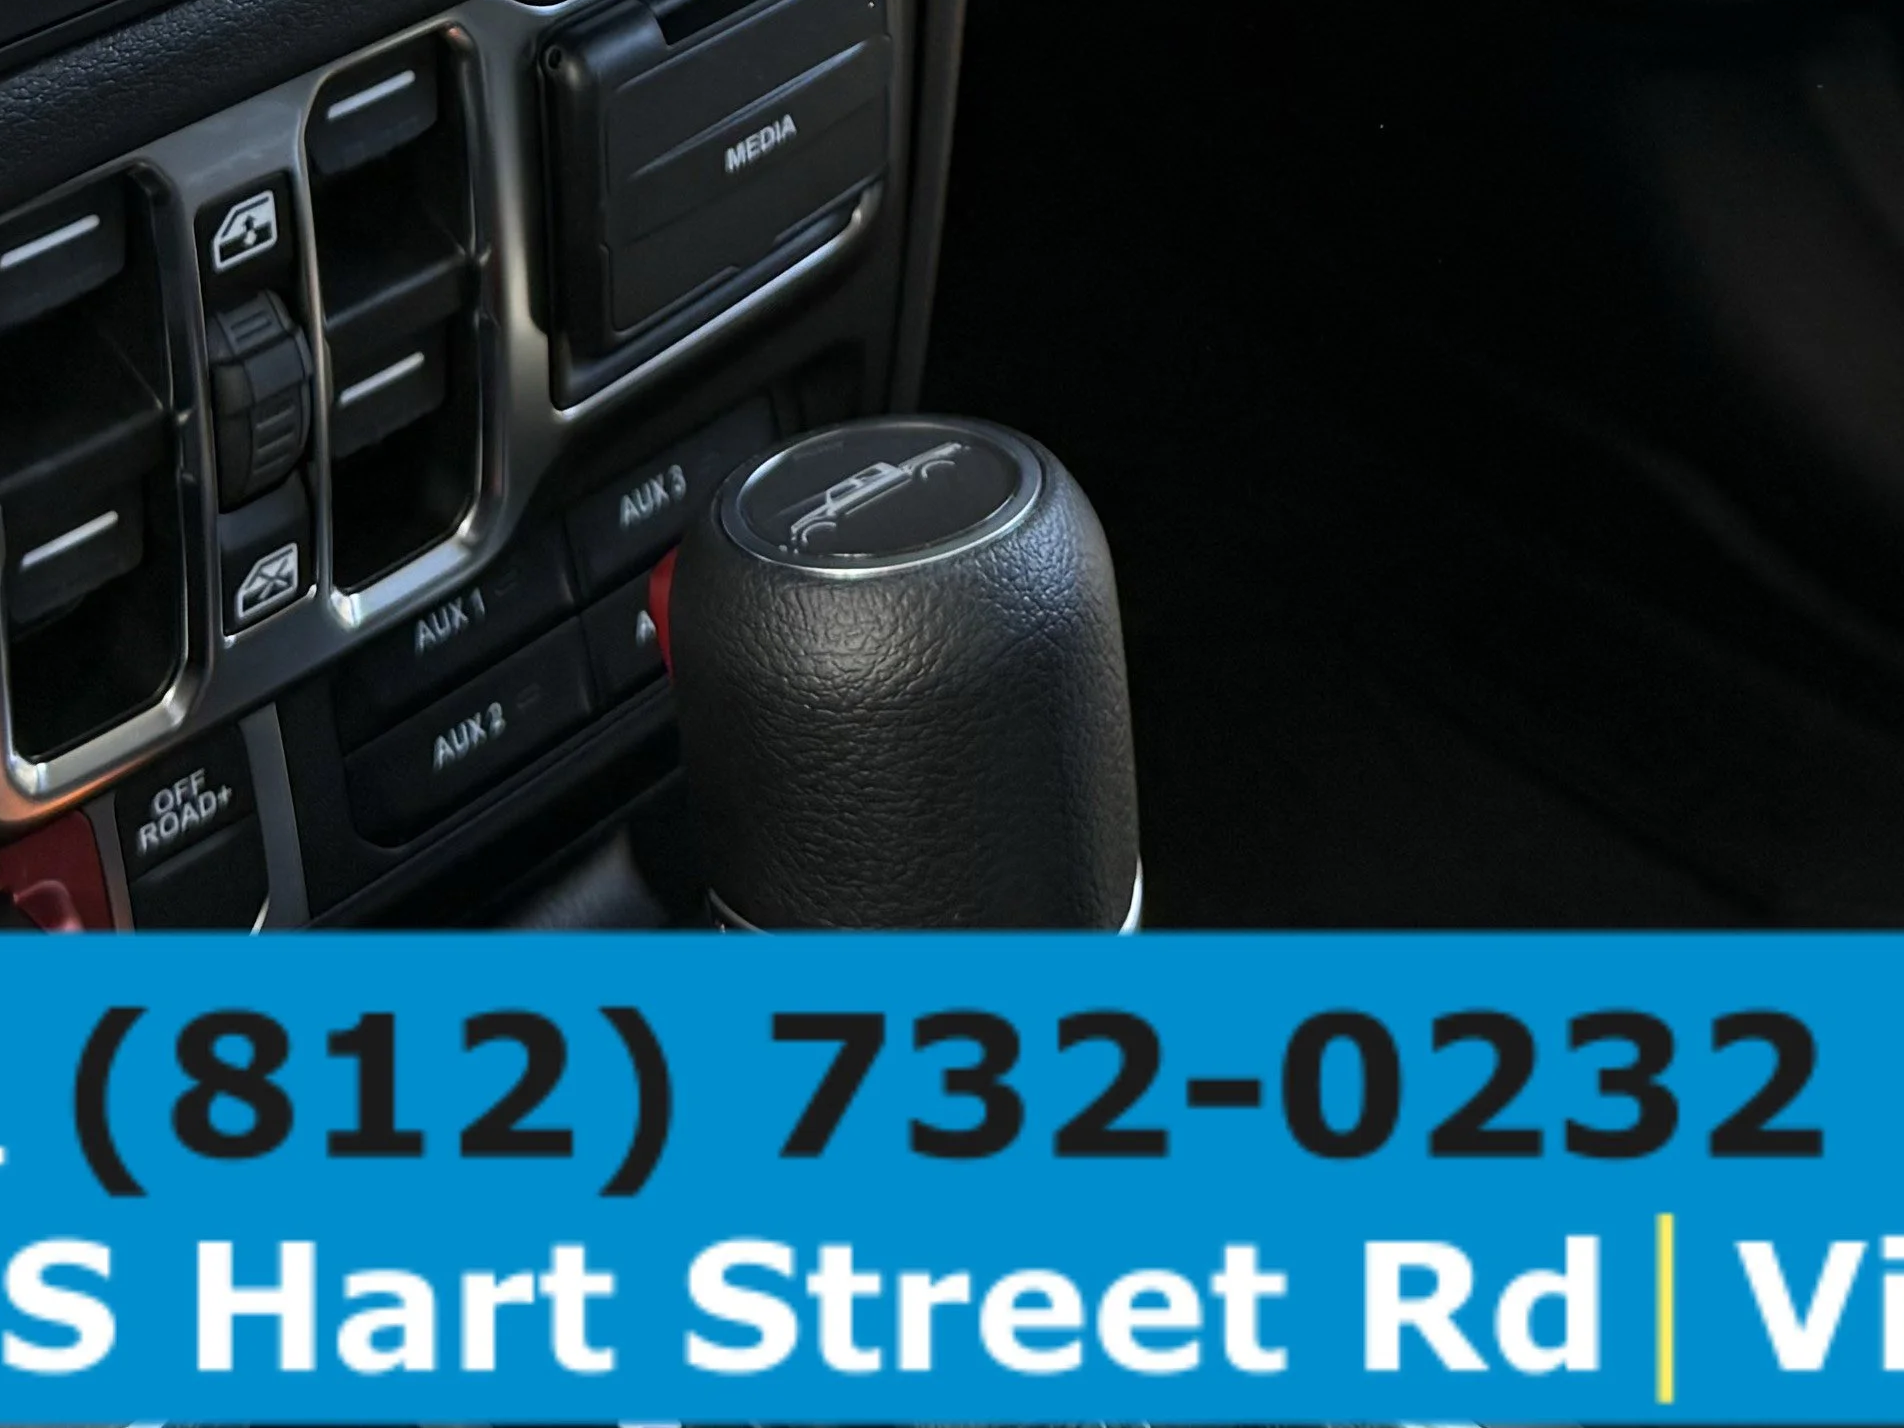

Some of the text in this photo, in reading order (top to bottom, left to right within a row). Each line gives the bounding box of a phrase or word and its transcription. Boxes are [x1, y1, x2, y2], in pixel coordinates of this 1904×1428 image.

[725, 113, 798, 173] MEDIA
[618, 473, 670, 528] AUX
[414, 588, 487, 659] AUX 1
[433, 711, 487, 771] AUX
[136, 784, 234, 855] ROAD+
[152, 767, 207, 816] OFF
